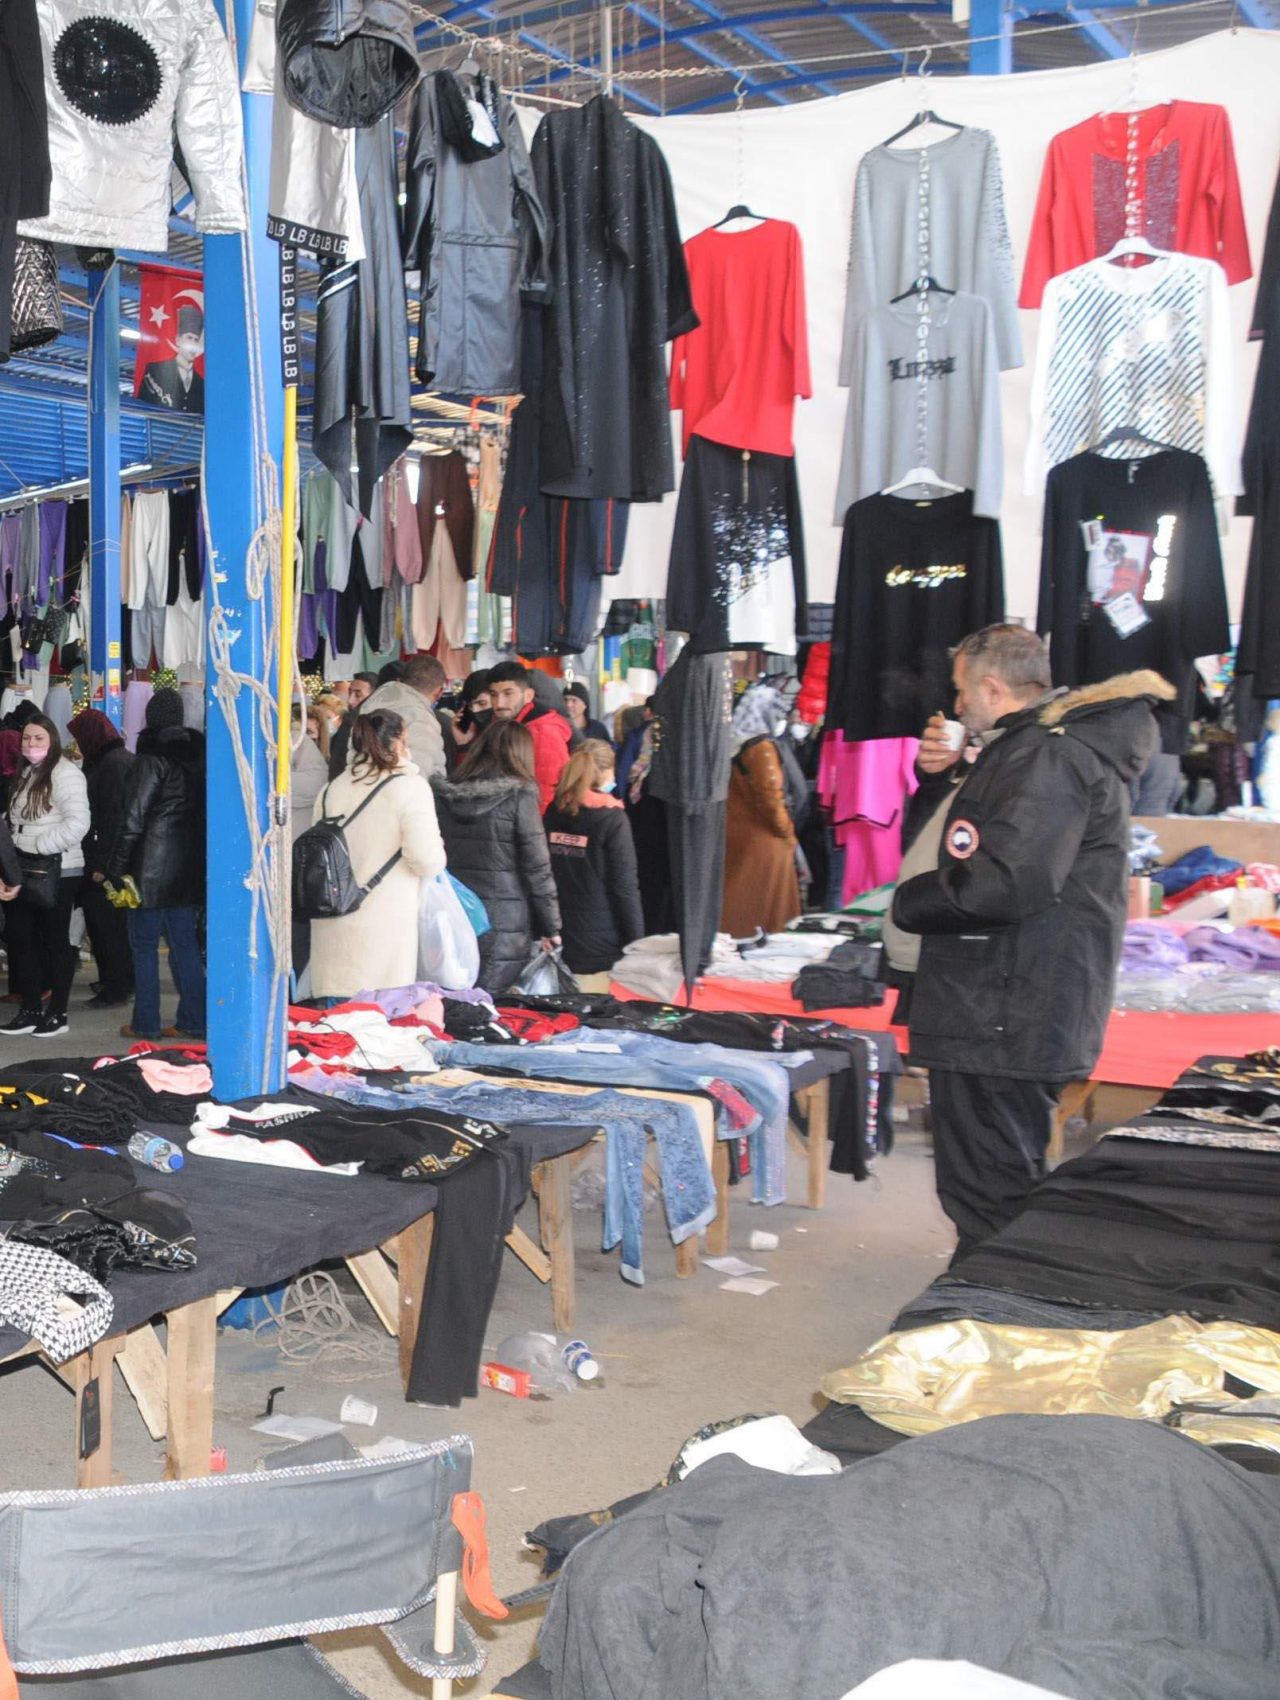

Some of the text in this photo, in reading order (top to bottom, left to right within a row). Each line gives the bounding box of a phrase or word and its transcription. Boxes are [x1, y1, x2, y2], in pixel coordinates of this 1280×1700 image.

[289, 226, 308, 243] LB
[320, 235, 332, 251] LB
[333, 238, 349, 254] LB
[282, 266, 294, 284] LB
[282, 288, 295, 307] LB
[281, 312, 295, 331] LB
[283, 335, 297, 354] LB
[284, 359, 298, 378] LB
